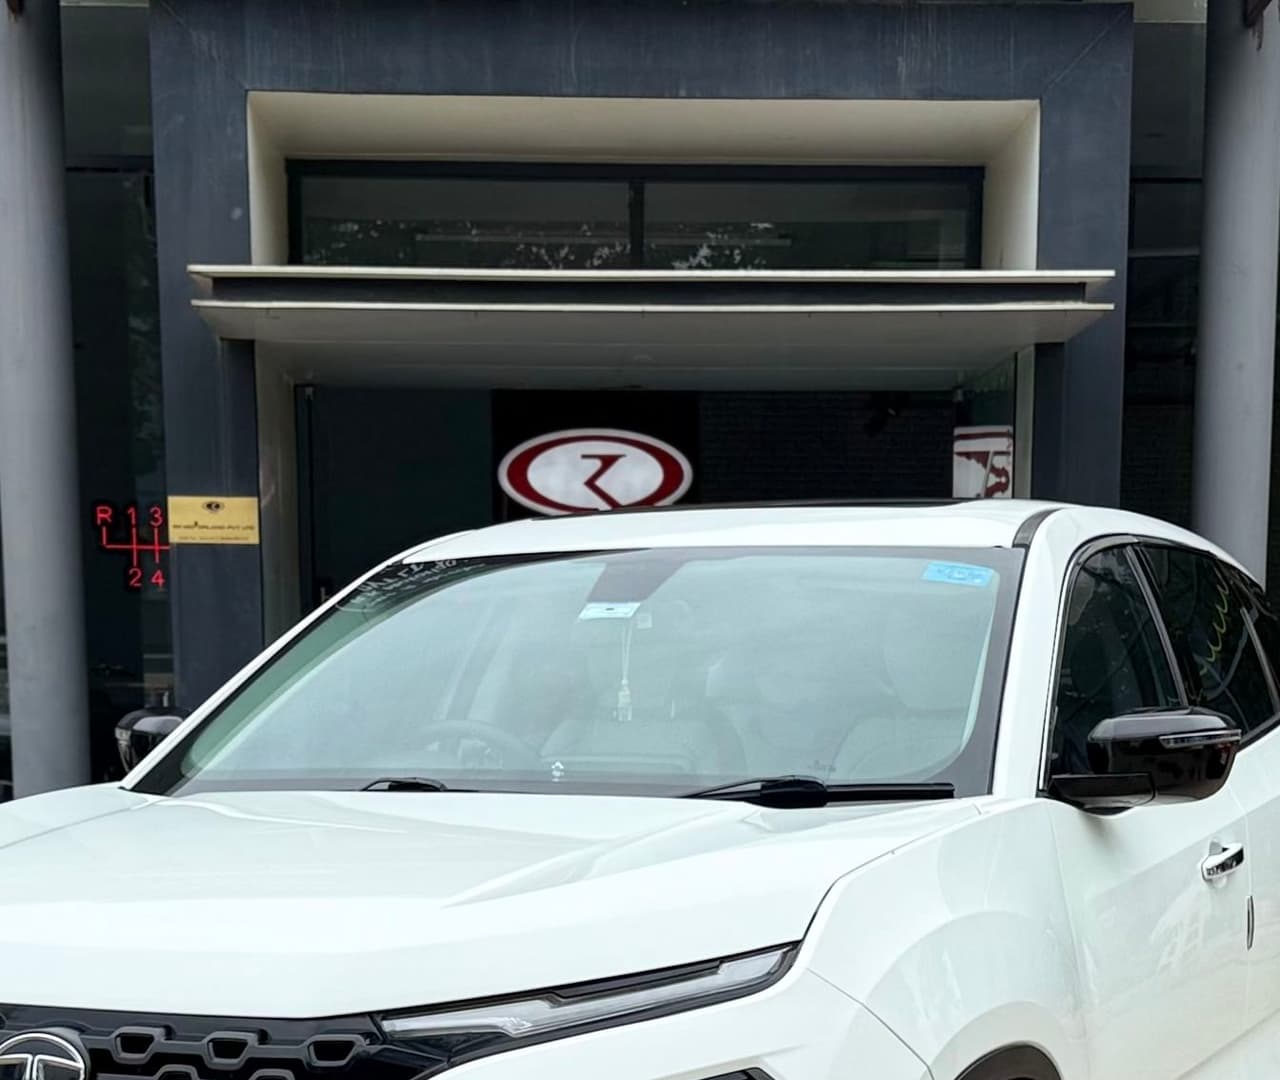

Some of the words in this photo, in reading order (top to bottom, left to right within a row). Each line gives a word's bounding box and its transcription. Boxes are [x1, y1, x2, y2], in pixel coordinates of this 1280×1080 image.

[96, 506, 113, 525] R
[128, 507, 136, 525] 1
[150, 507, 163, 526] 3
[129, 568, 142, 586] 2
[151, 570, 165, 588] 4
